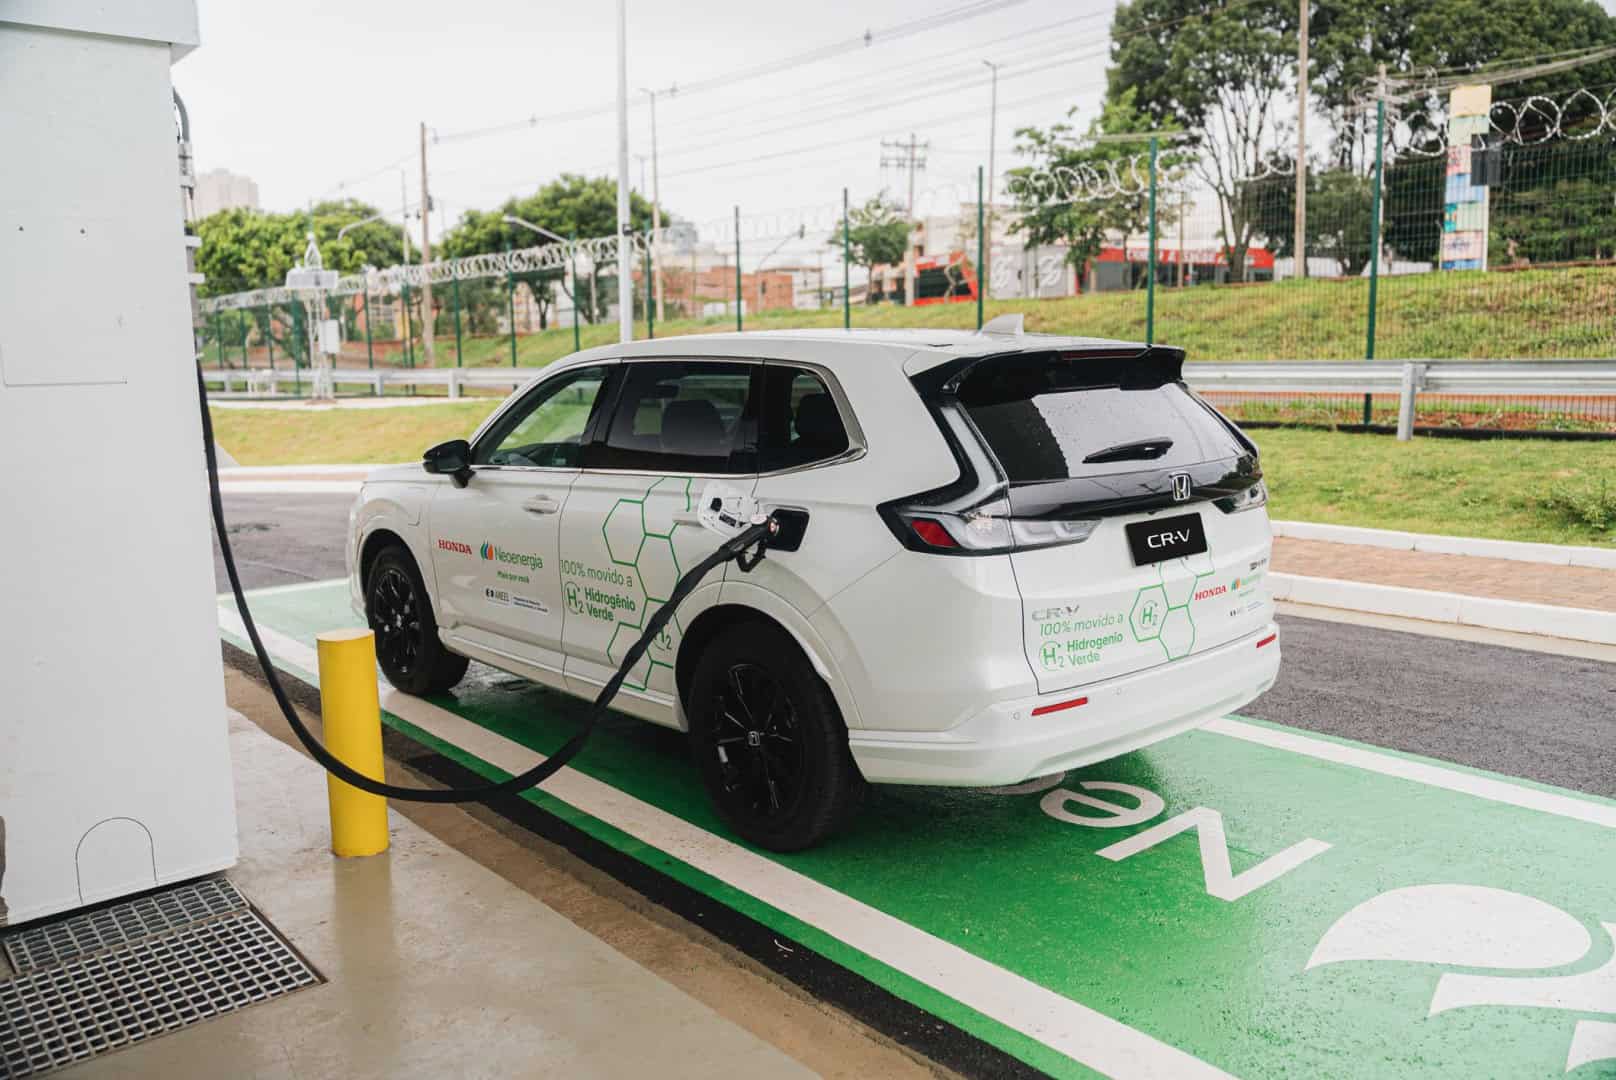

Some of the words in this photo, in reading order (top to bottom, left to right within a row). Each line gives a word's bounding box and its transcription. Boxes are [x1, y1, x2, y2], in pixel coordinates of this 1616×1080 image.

[438, 539, 473, 555] HONDA
[494, 546, 544, 571] Neoenergia
[560, 560, 586, 578] 100%
[587, 568, 624, 586] movido
[626, 576, 633, 588] a
[584, 587, 636, 612] Hidrogênio
[1194, 584, 1228, 600] HONDA
[586, 603, 614, 622] Verde
[1040, 621, 1071, 637] 100%
[1074, 614, 1115, 632] movido
[1117, 613, 1124, 623] a
[1068, 651, 1101, 667] Verde
